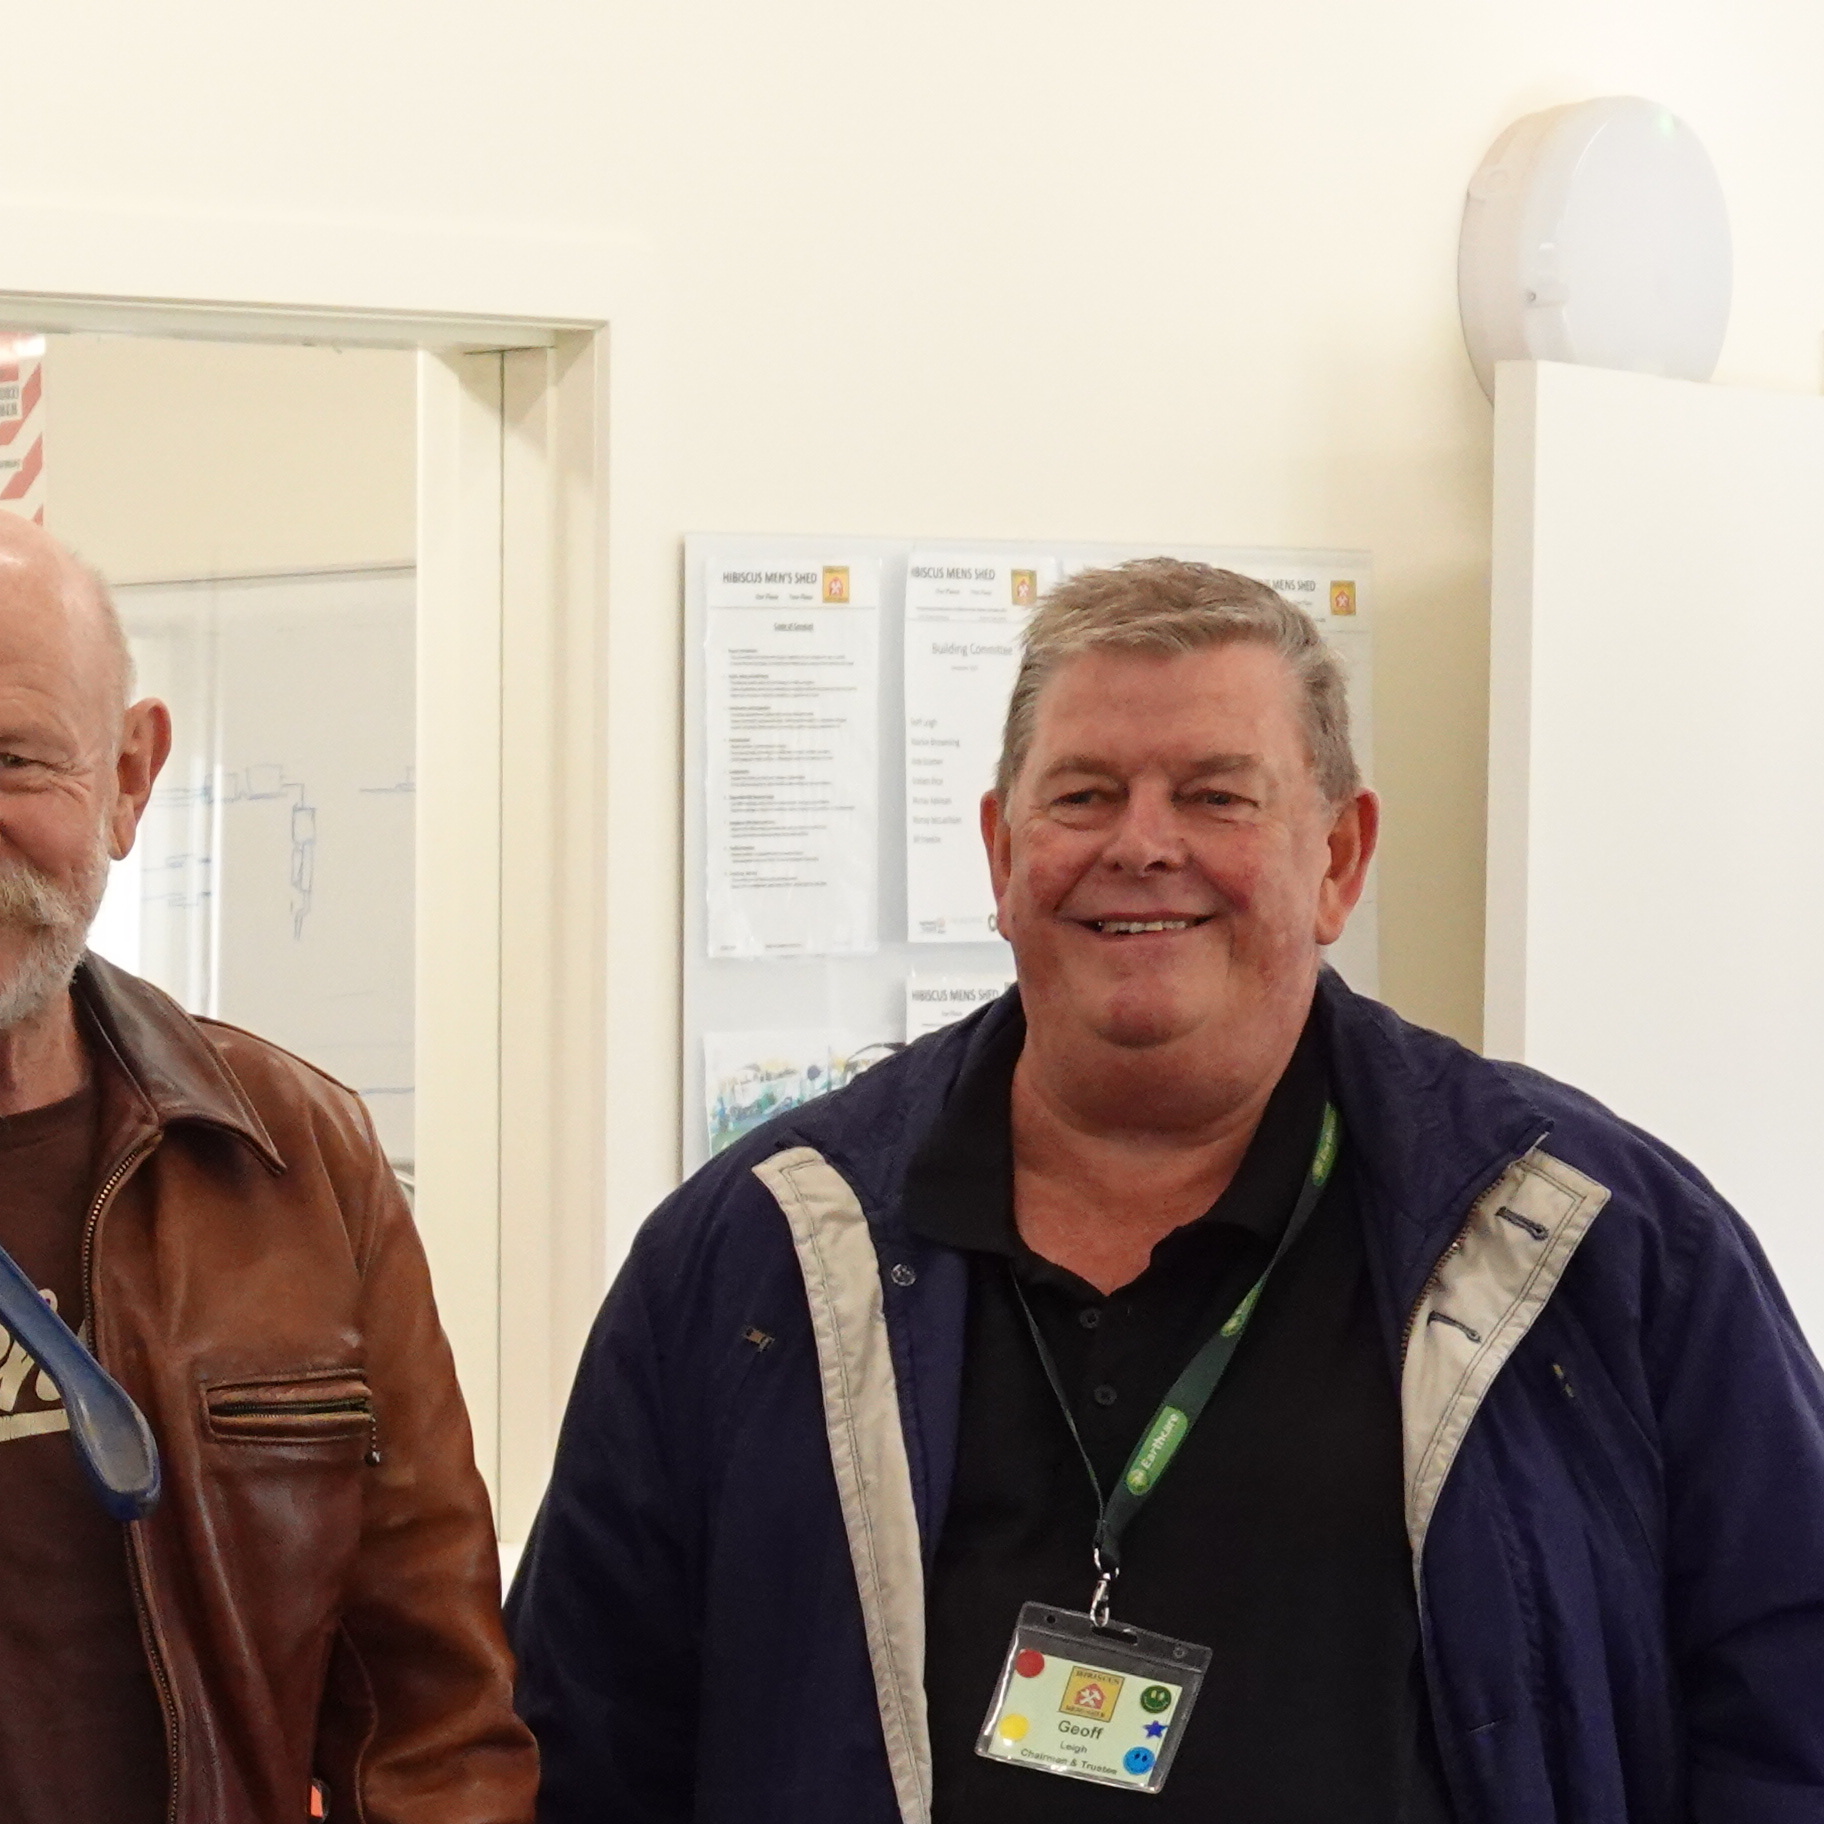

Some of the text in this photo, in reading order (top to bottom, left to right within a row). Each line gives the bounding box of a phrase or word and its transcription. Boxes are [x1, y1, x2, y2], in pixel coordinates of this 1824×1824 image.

[722, 572, 817, 584] HIBISCUS MEN'S SHED
[946, 568, 972, 580] MENS
[974, 568, 996, 580] SHED
[931, 643, 968, 657] Building
[1058, 1719, 1104, 1739] Geoff
[1060, 1740, 1088, 1754] Leigh
[1070, 1758, 1077, 1767] &
[1081, 1760, 1117, 1775] Trustee
